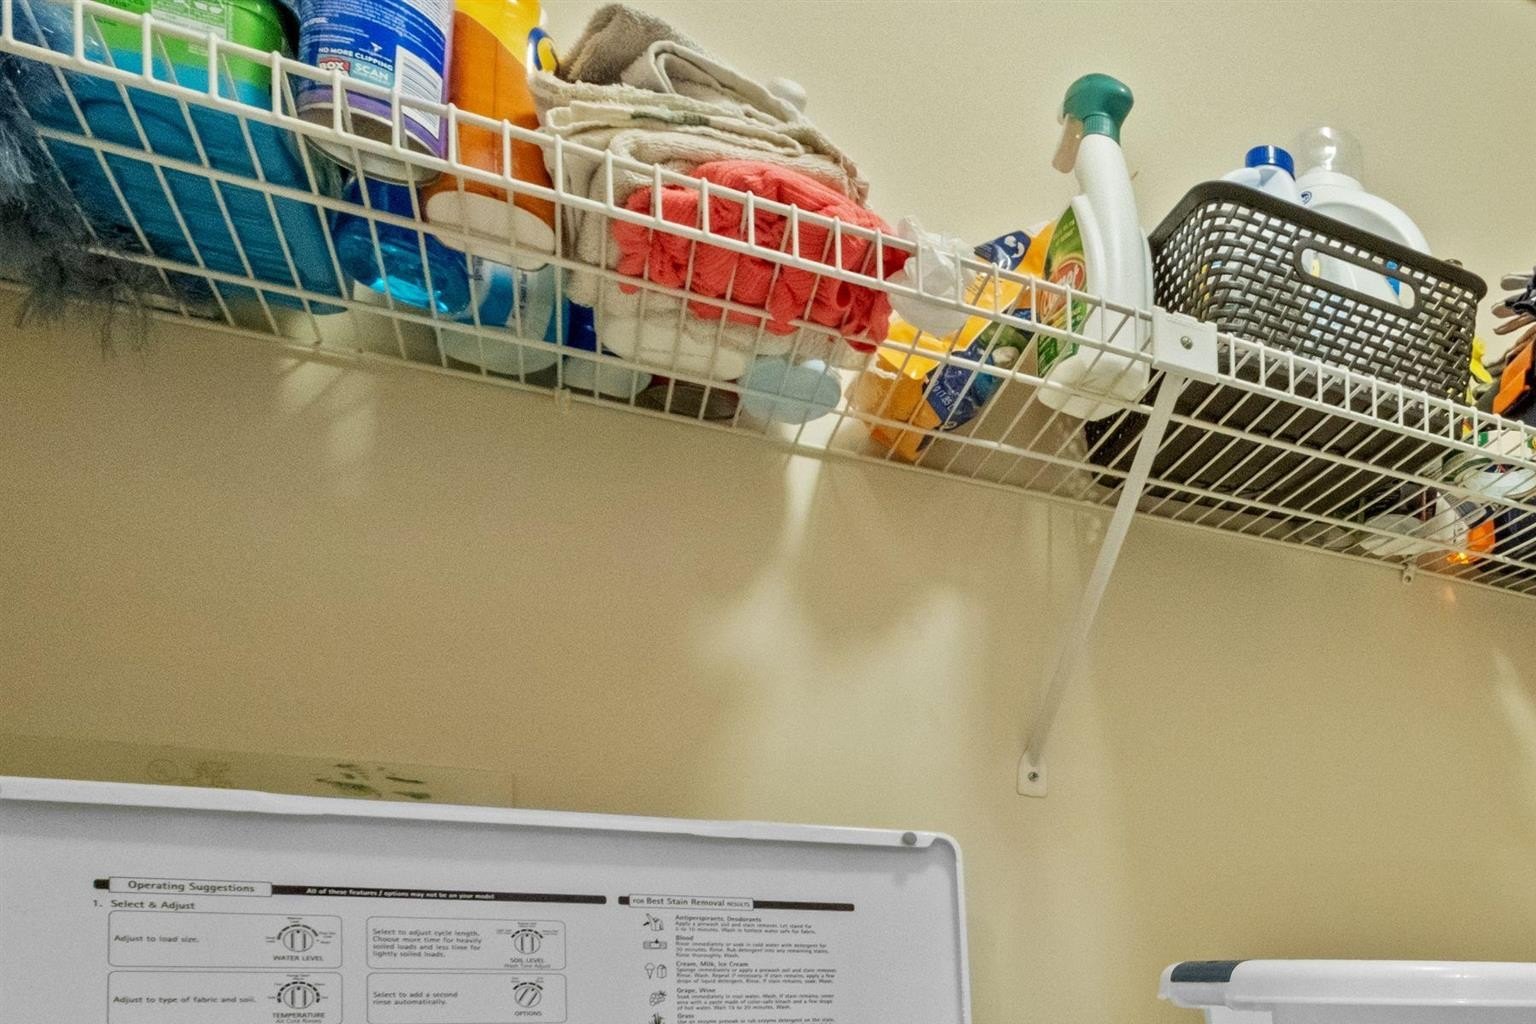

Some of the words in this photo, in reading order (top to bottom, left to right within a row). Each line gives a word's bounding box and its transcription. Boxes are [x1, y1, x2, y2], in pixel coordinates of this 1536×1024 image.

[330, 47, 354, 57] MORE
[355, 52, 393, 72] CLIPPING
[355, 63, 389, 81] SCAN
[128, 880, 185, 893] Operating
[188, 882, 256, 894] Suggestions
[348, 889, 377, 897] features
[384, 891, 409, 899] options
[92, 899, 103, 908] 1.
[110, 899, 145, 909] Select
[148, 901, 157, 909] &
[161, 901, 196, 911] Adjust
[646, 897, 665, 905] Best
[666, 898, 688, 906] Stain
[690, 898, 725, 907] Removal
[372, 928, 397, 936] Select
[409, 929, 432, 938] adjust
[434, 929, 452, 938] cycle
[113, 934, 143, 944] Adjust
[146, 935, 156, 943] to
[159, 934, 178, 943] load
[180, 935, 200, 943] size.
[372, 936, 399, 944] Choose
[423, 936, 440, 944] time
[443, 936, 455, 944] for
[372, 990, 397, 999] Select
[398, 991, 407, 999] to
[409, 991, 424, 999] add
[113, 996, 143, 1005] Adjust
[159, 996, 179, 1005] type
[192, 996, 219, 1004] fabric
[220, 996, 238, 1004] and
[272, 1011, 326, 1019] TEMPERATURE
